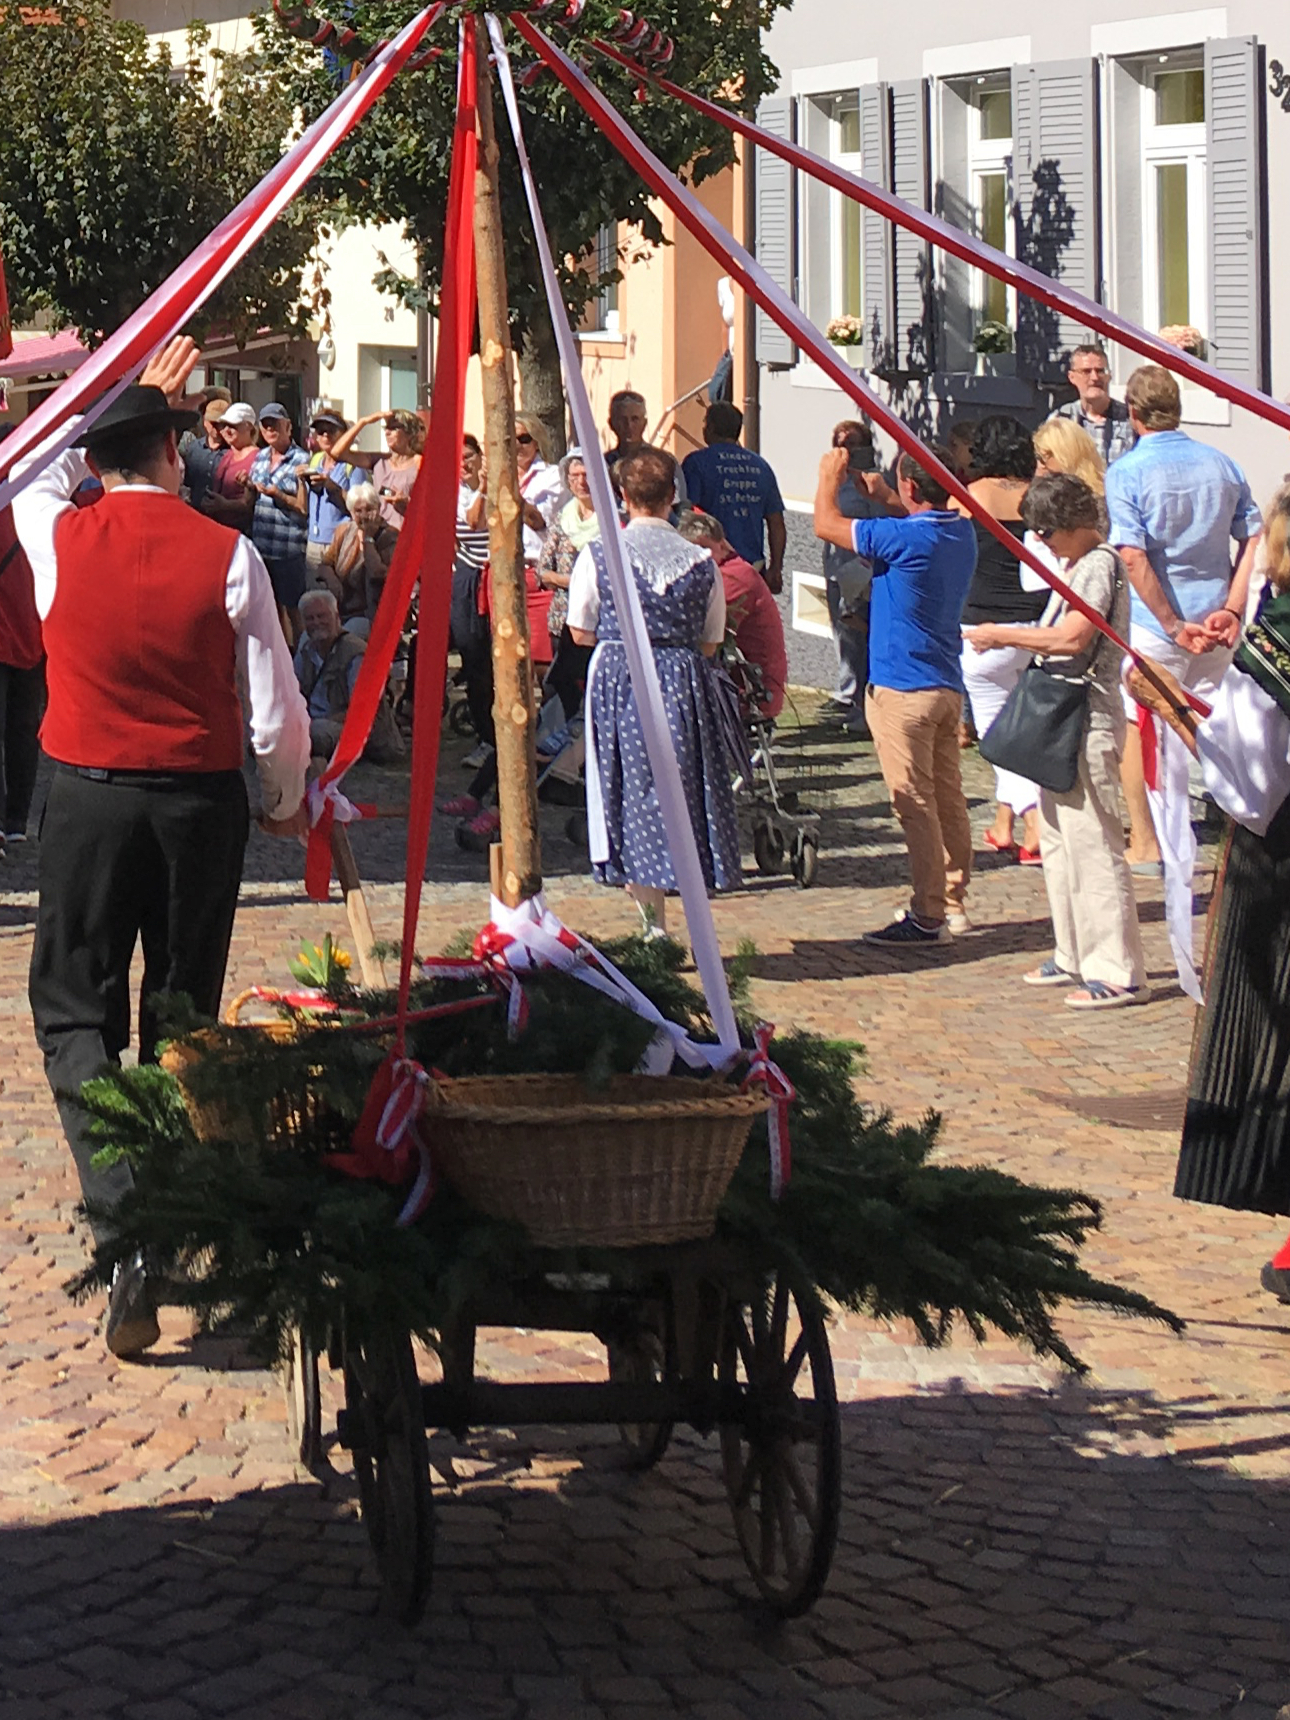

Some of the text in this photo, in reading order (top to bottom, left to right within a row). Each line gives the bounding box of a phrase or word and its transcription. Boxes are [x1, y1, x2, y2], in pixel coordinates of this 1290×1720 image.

[718, 452, 752, 460] Kinder
[716, 464, 761, 474] Trachten
[723, 479, 757, 490] Gruppe
